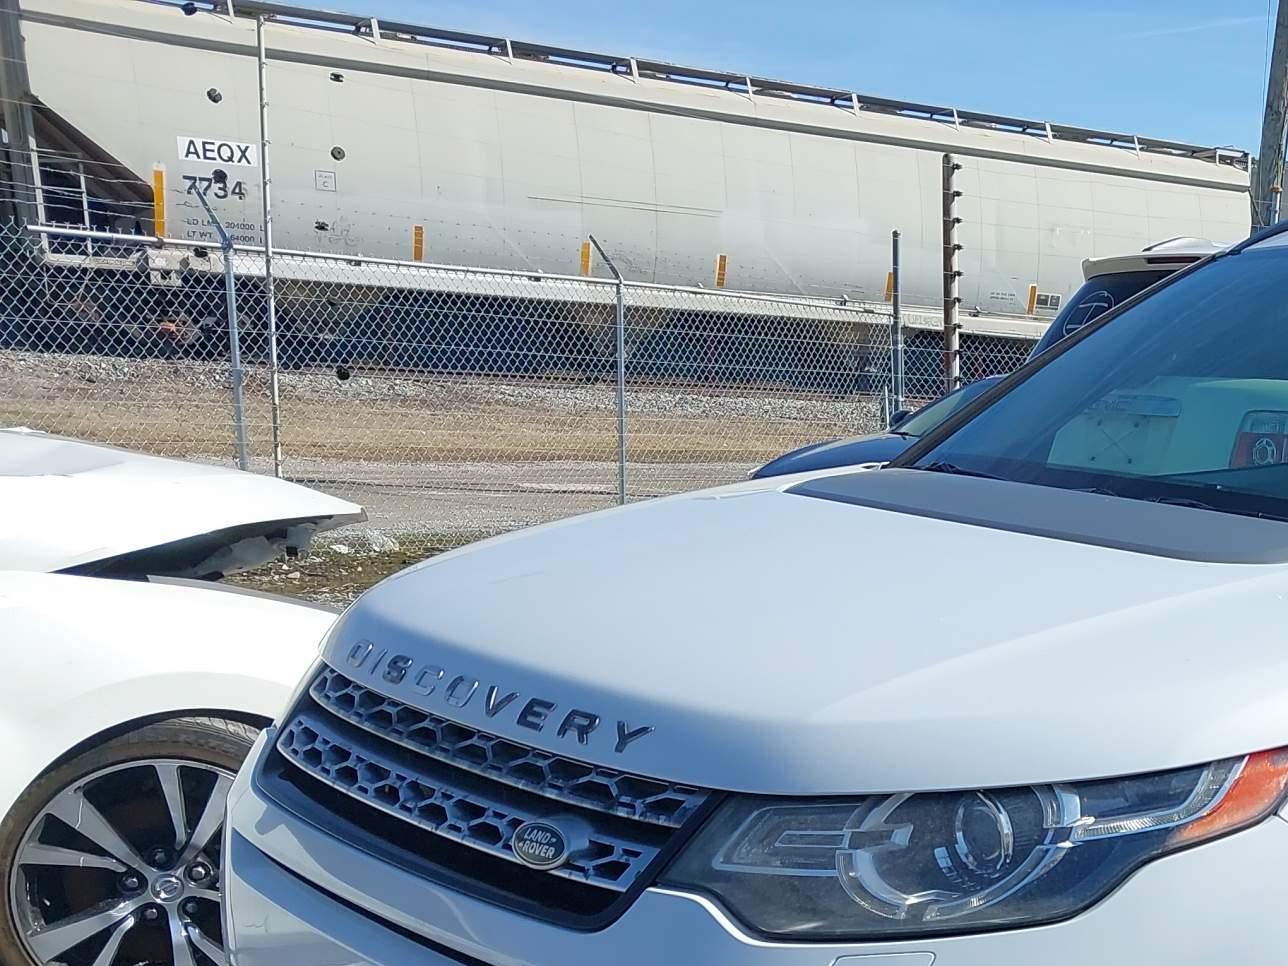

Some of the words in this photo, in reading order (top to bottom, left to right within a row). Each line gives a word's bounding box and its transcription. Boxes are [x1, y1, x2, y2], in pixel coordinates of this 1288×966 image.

[184, 139, 252, 165] AEQX
[182, 175, 246, 200] 7734
[346, 639, 656, 753] DISCOVERY
[523, 827, 552, 844] LAND
[522, 840, 556, 859] ROVER
